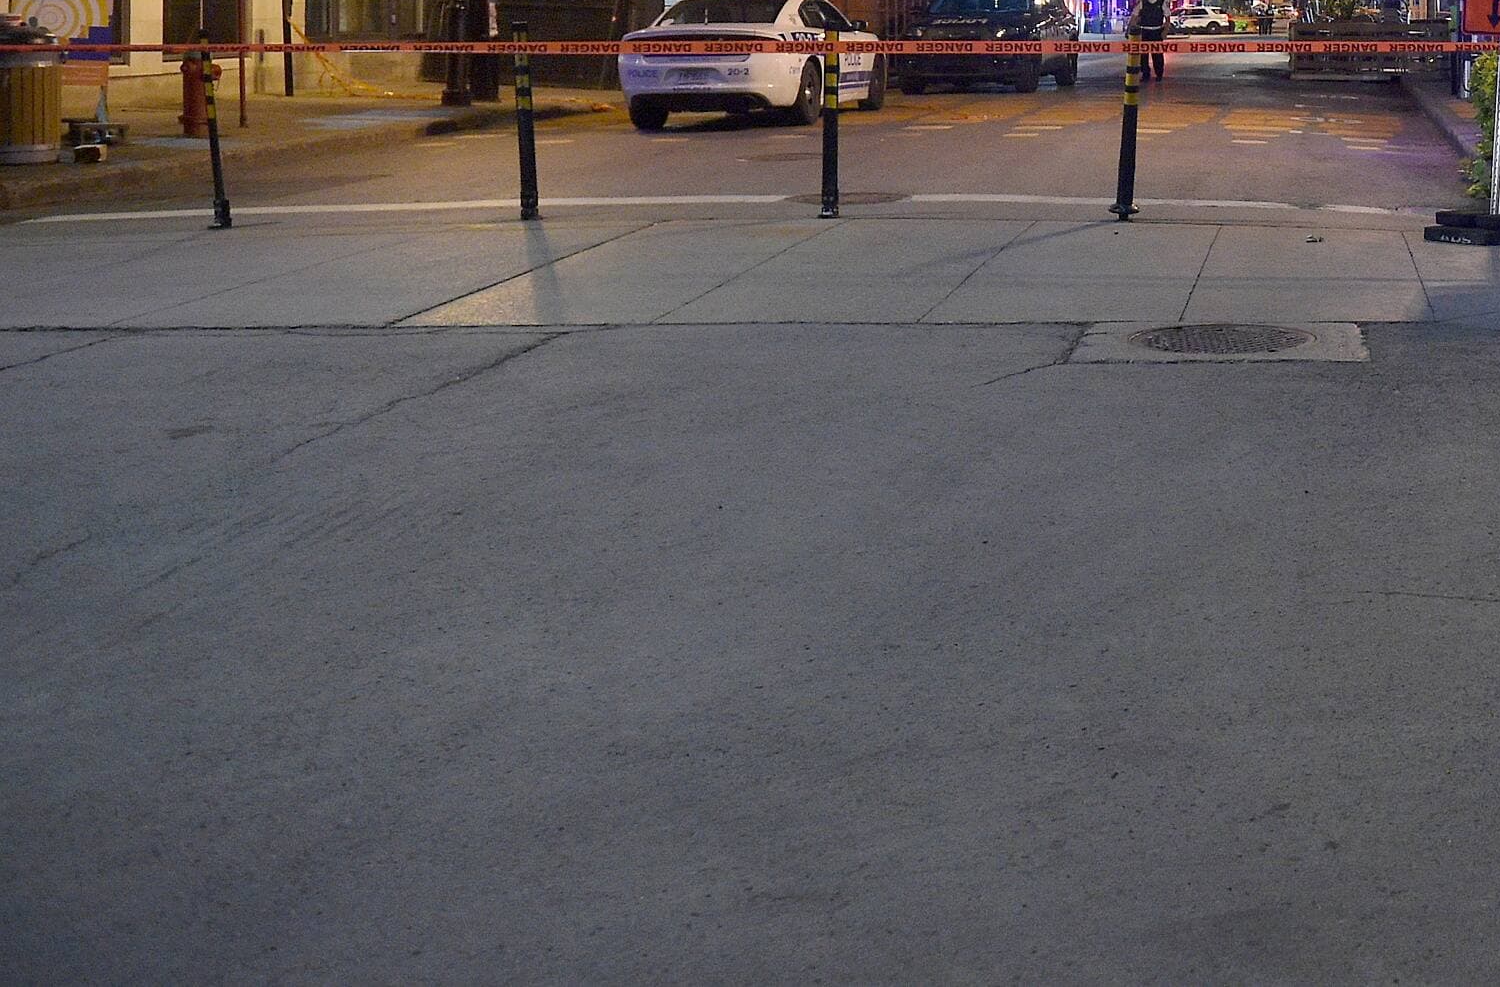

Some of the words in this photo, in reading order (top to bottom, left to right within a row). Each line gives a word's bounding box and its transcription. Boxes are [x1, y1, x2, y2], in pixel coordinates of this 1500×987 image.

[560, 43, 620, 53] DANGER
[632, 43, 692, 53] DANGER
[703, 43, 763, 53] DANGER
[775, 43, 835, 53] DANGER
[846, 43, 904, 53] DANGER
[916, 42, 973, 52] DANGER
[985, 42, 1042, 52] DANGER
[1054, 42, 1111, 52] DANGER
[1122, 42, 1178, 52] DANGER
[1190, 42, 1245, 53] DANGER
[1257, 42, 1312, 53] DANGER
[1323, 42, 1378, 53] DANGER
[1389, 42, 1444, 53] DANGER
[627, 69, 657, 78] POLICE
[727, 67, 749, 76] 20-2
